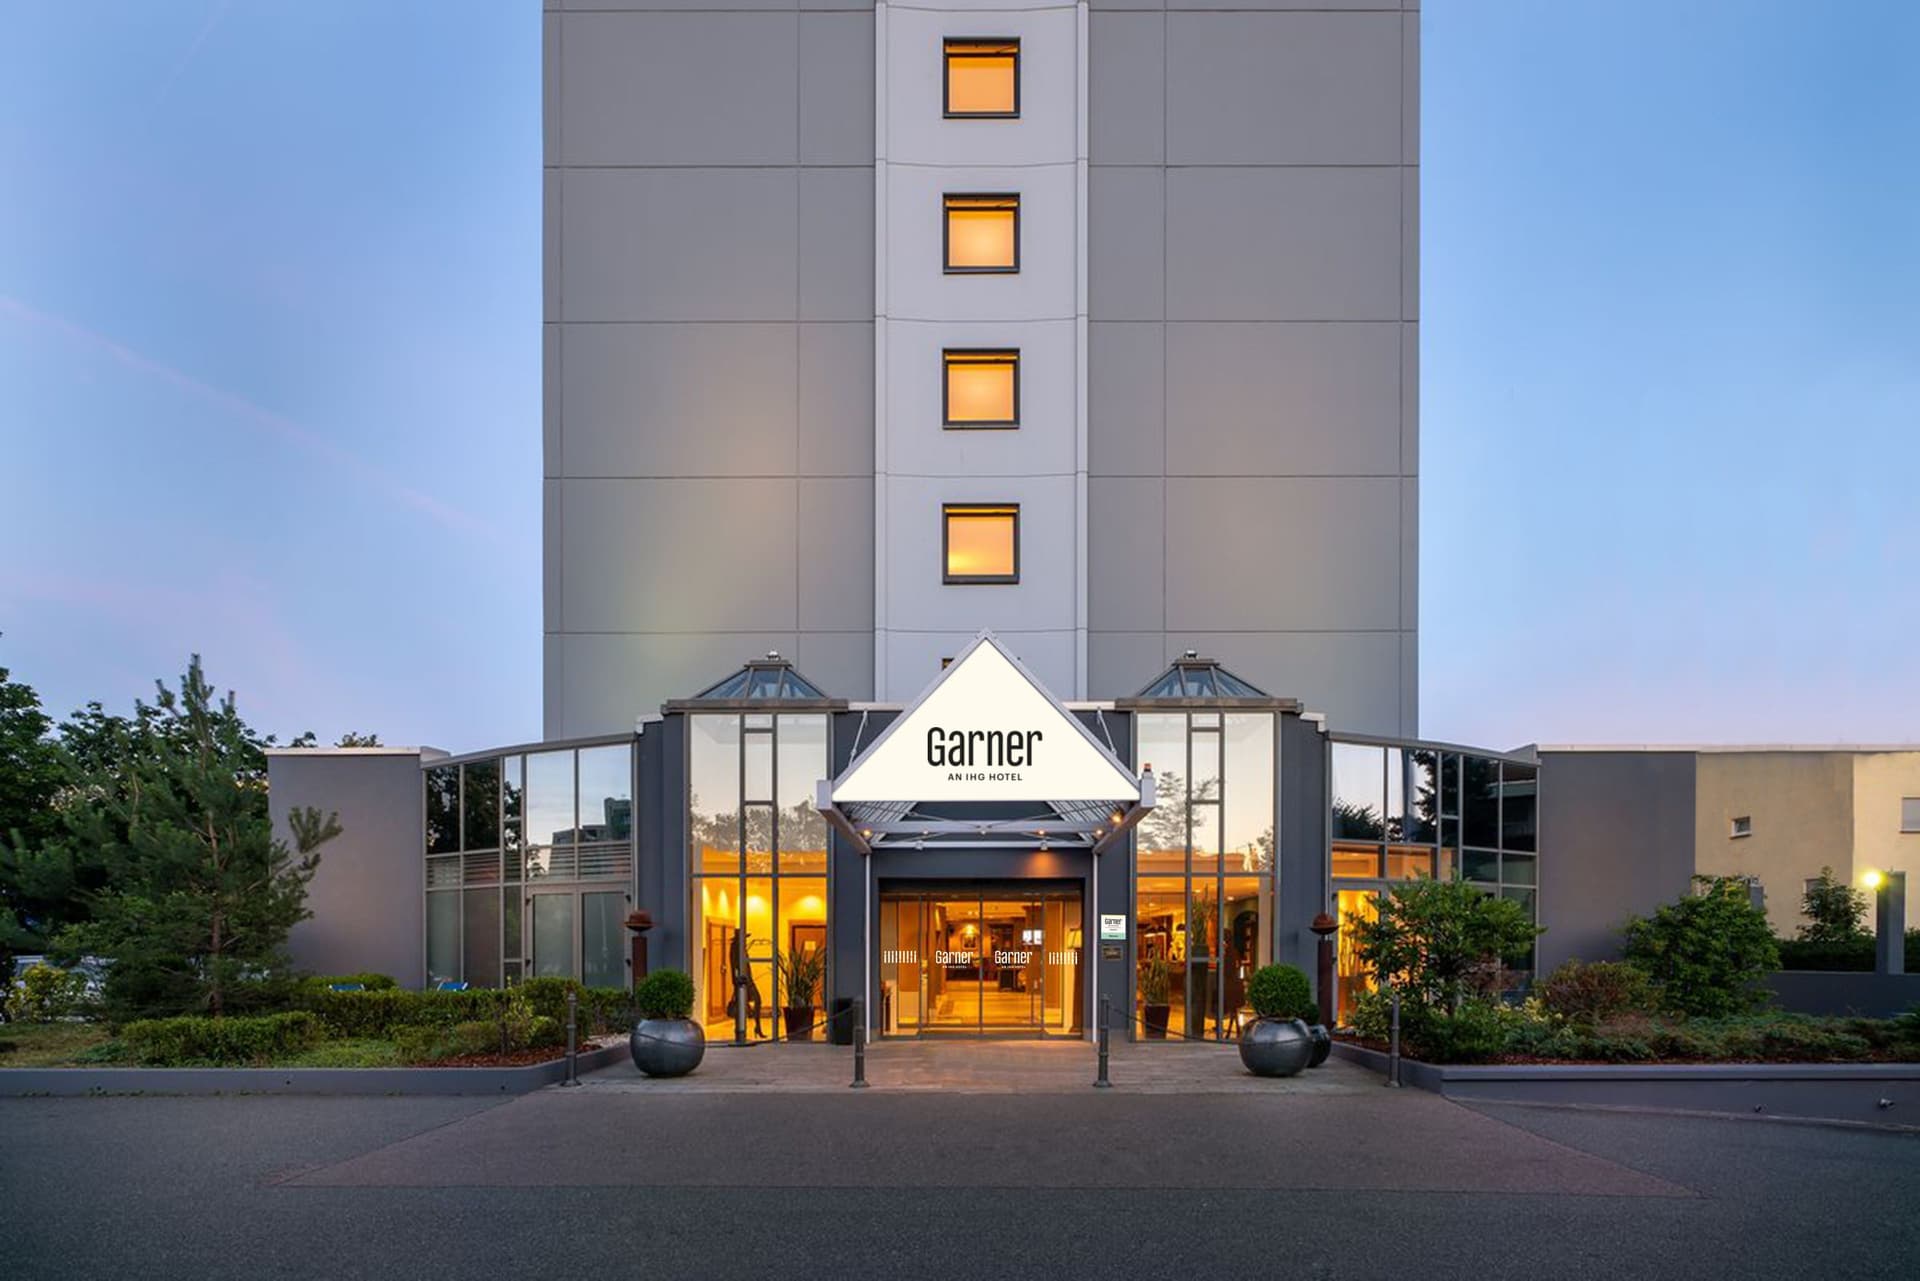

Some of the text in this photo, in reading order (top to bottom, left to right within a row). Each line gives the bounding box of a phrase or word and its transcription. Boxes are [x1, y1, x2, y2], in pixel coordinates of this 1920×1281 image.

[927, 726, 1043, 767] Garner
[947, 773, 1023, 781] AN IHG HOTEL
[935, 950, 974, 964] Garner
[994, 950, 1033, 964] Garner
